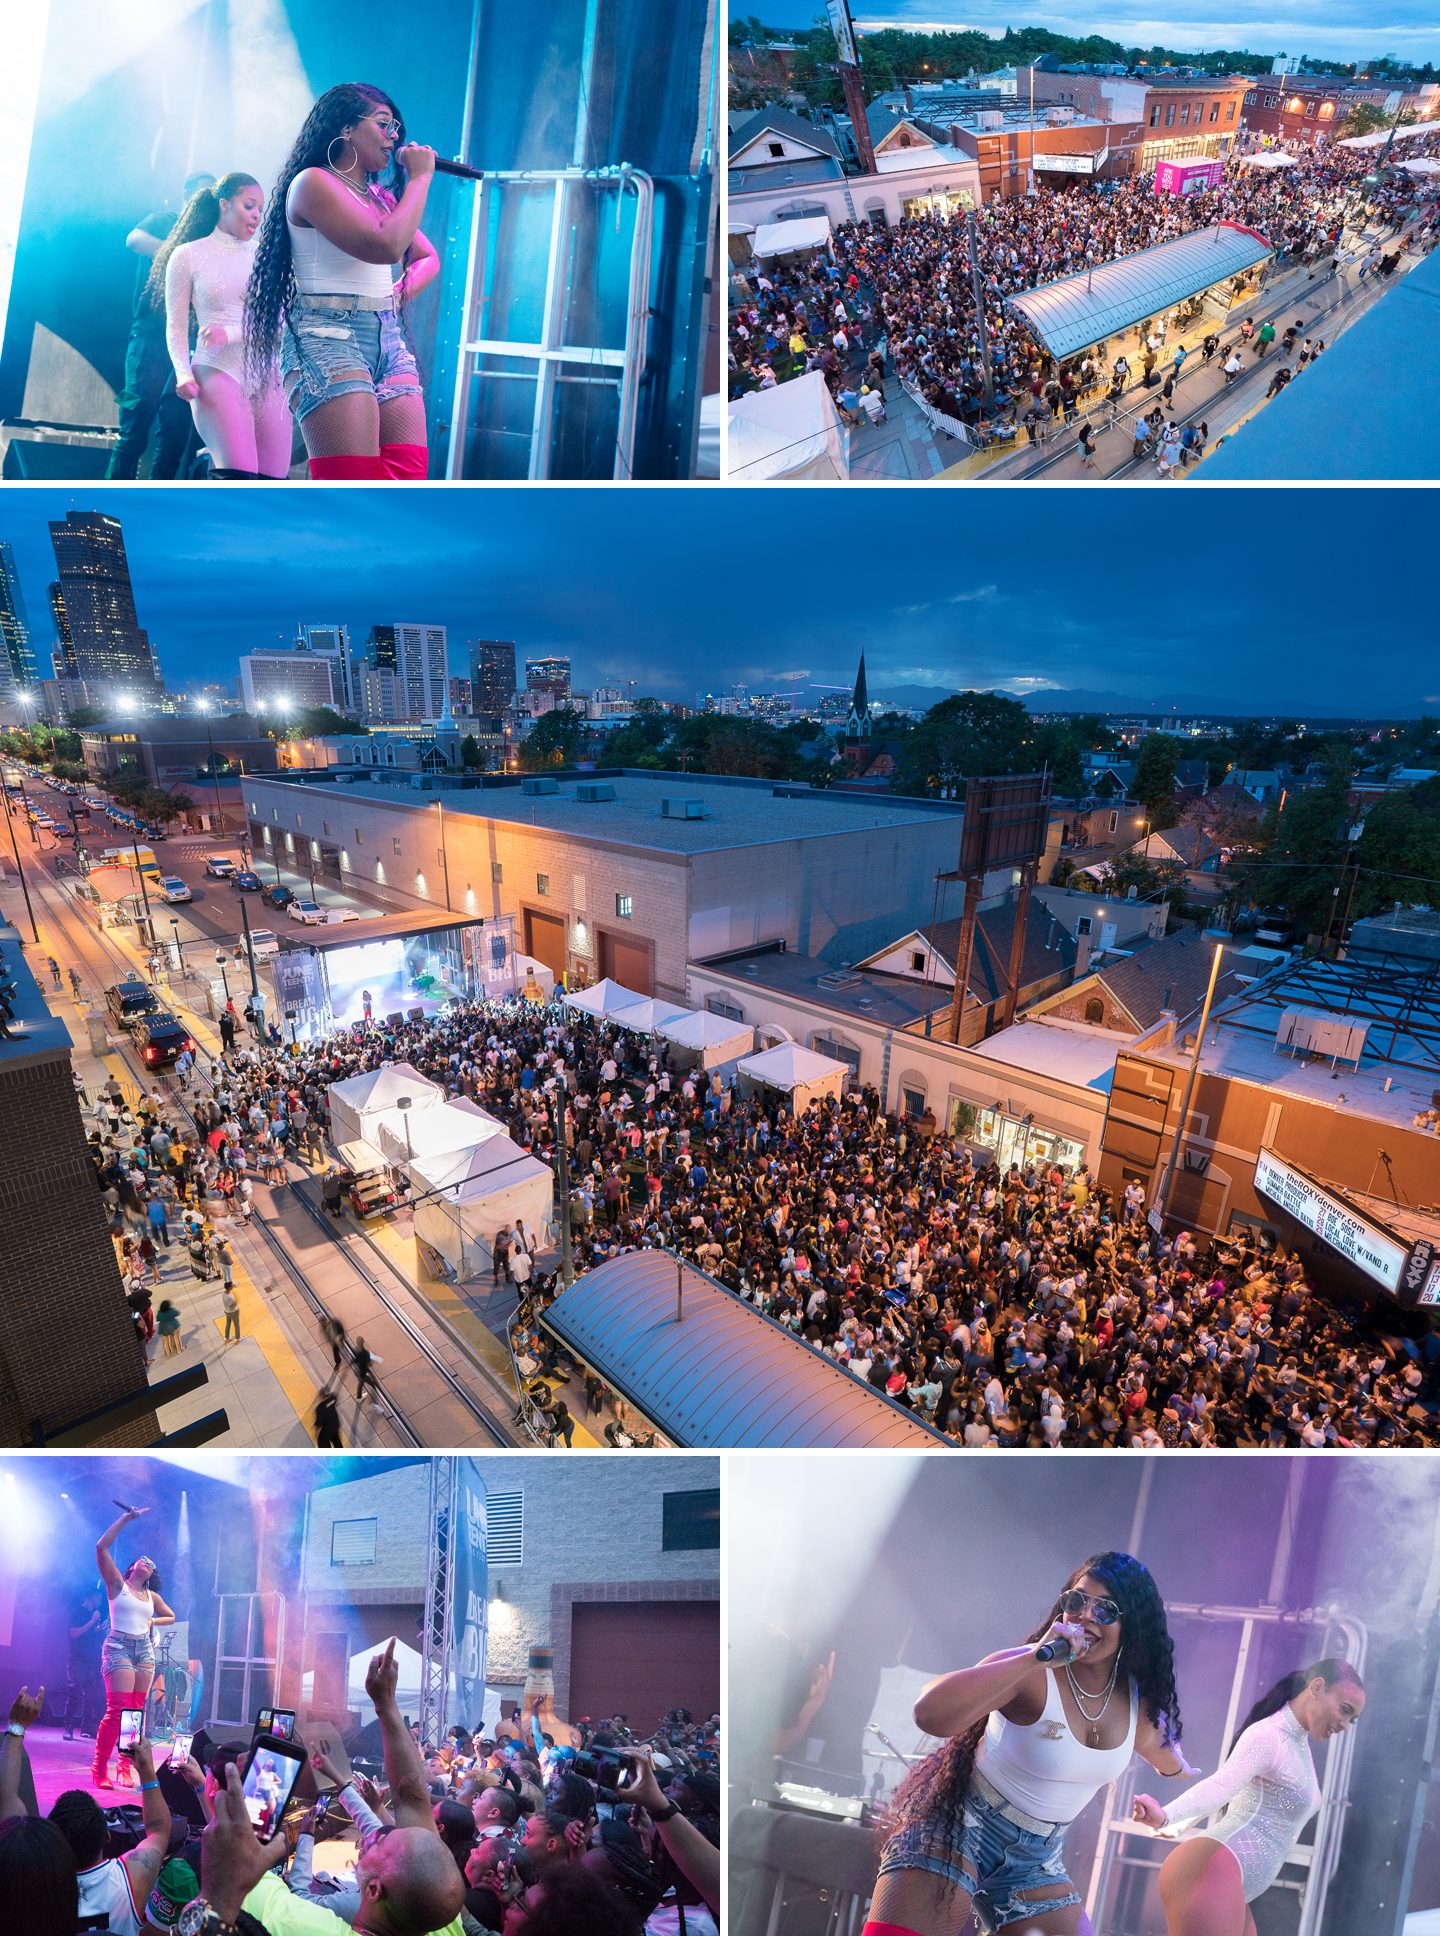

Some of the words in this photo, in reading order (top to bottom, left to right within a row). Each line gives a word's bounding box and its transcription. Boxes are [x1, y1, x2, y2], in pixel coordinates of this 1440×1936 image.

[282, 964, 314, 980] JUNE
[282, 975, 315, 987] TEENTH
[287, 995, 316, 1010] DREAM
[1266, 1177, 1283, 1195] SUMMER
[1284, 1190, 1301, 1209] BATTLE
[1269, 1169, 1284, 1185] DENVER
[1285, 1182, 1307, 1204] PRODUCER
[1286, 1172, 1366, 1235] theROXYdenver.com
[1325, 1222, 1340, 1239] LOCAL
[1343, 1235, 1356, 1249] LOVE
[1419, 1240, 1431, 1248] THE
[1406, 1245, 1430, 1289] ROXY
[1427, 1284, 1436, 1293] 17
[1422, 1293, 1434, 1303] 20
[780, 1792, 821, 1806] Pioneer
